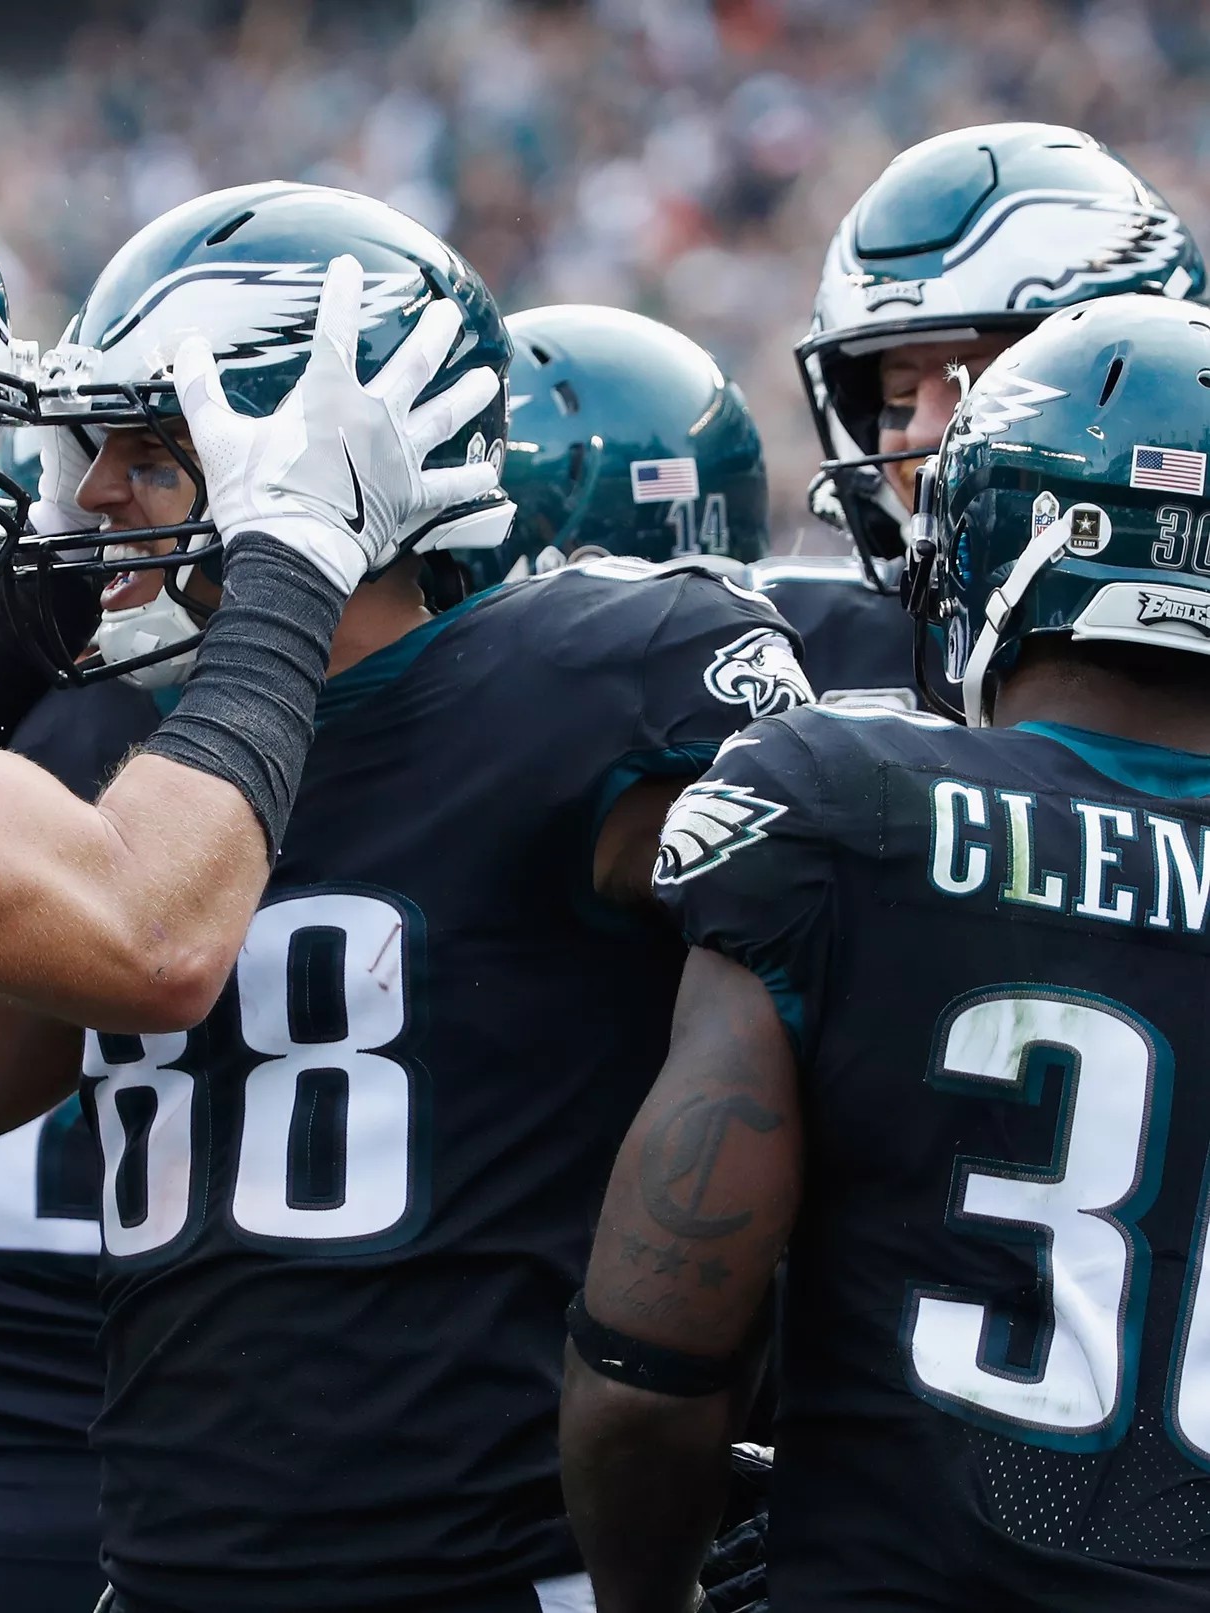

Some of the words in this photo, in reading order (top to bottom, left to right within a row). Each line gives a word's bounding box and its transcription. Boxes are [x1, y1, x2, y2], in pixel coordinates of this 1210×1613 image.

[665, 493, 730, 556] 14
[1138, 591, 1210, 629] EAGLE
[80, 882, 430, 1258] 88
[902, 983, 1210, 1456] 3
